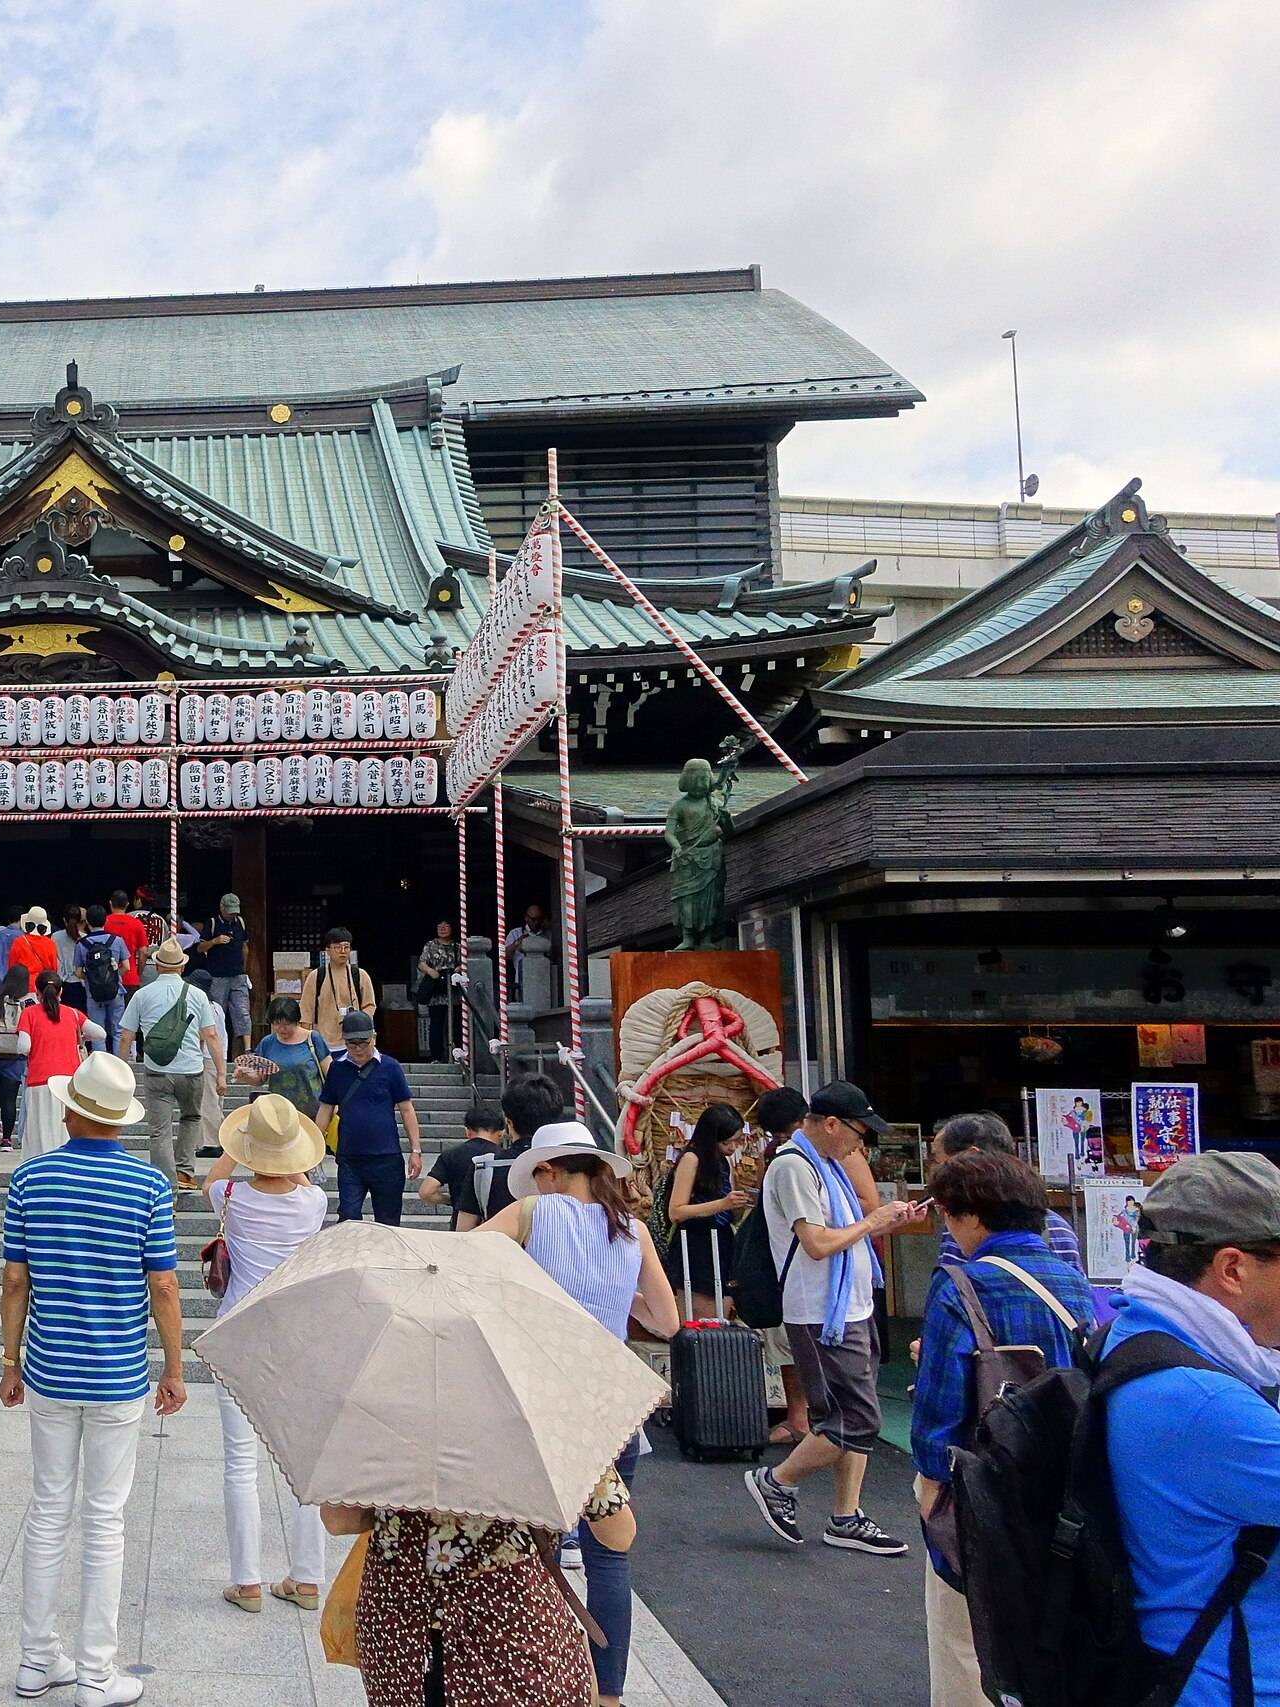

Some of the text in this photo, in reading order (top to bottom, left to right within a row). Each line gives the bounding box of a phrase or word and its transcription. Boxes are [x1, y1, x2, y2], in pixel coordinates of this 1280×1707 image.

[362, 693, 375, 734] 石川栄司
[388, 694, 402, 734] 新井昭三
[46, 763, 57, 802] 宮本洋一
[415, 758, 426, 802] 松田和世
[1164, 1096, 1181, 1125] 仕事
[1157, 1126, 1174, 1144] 守
